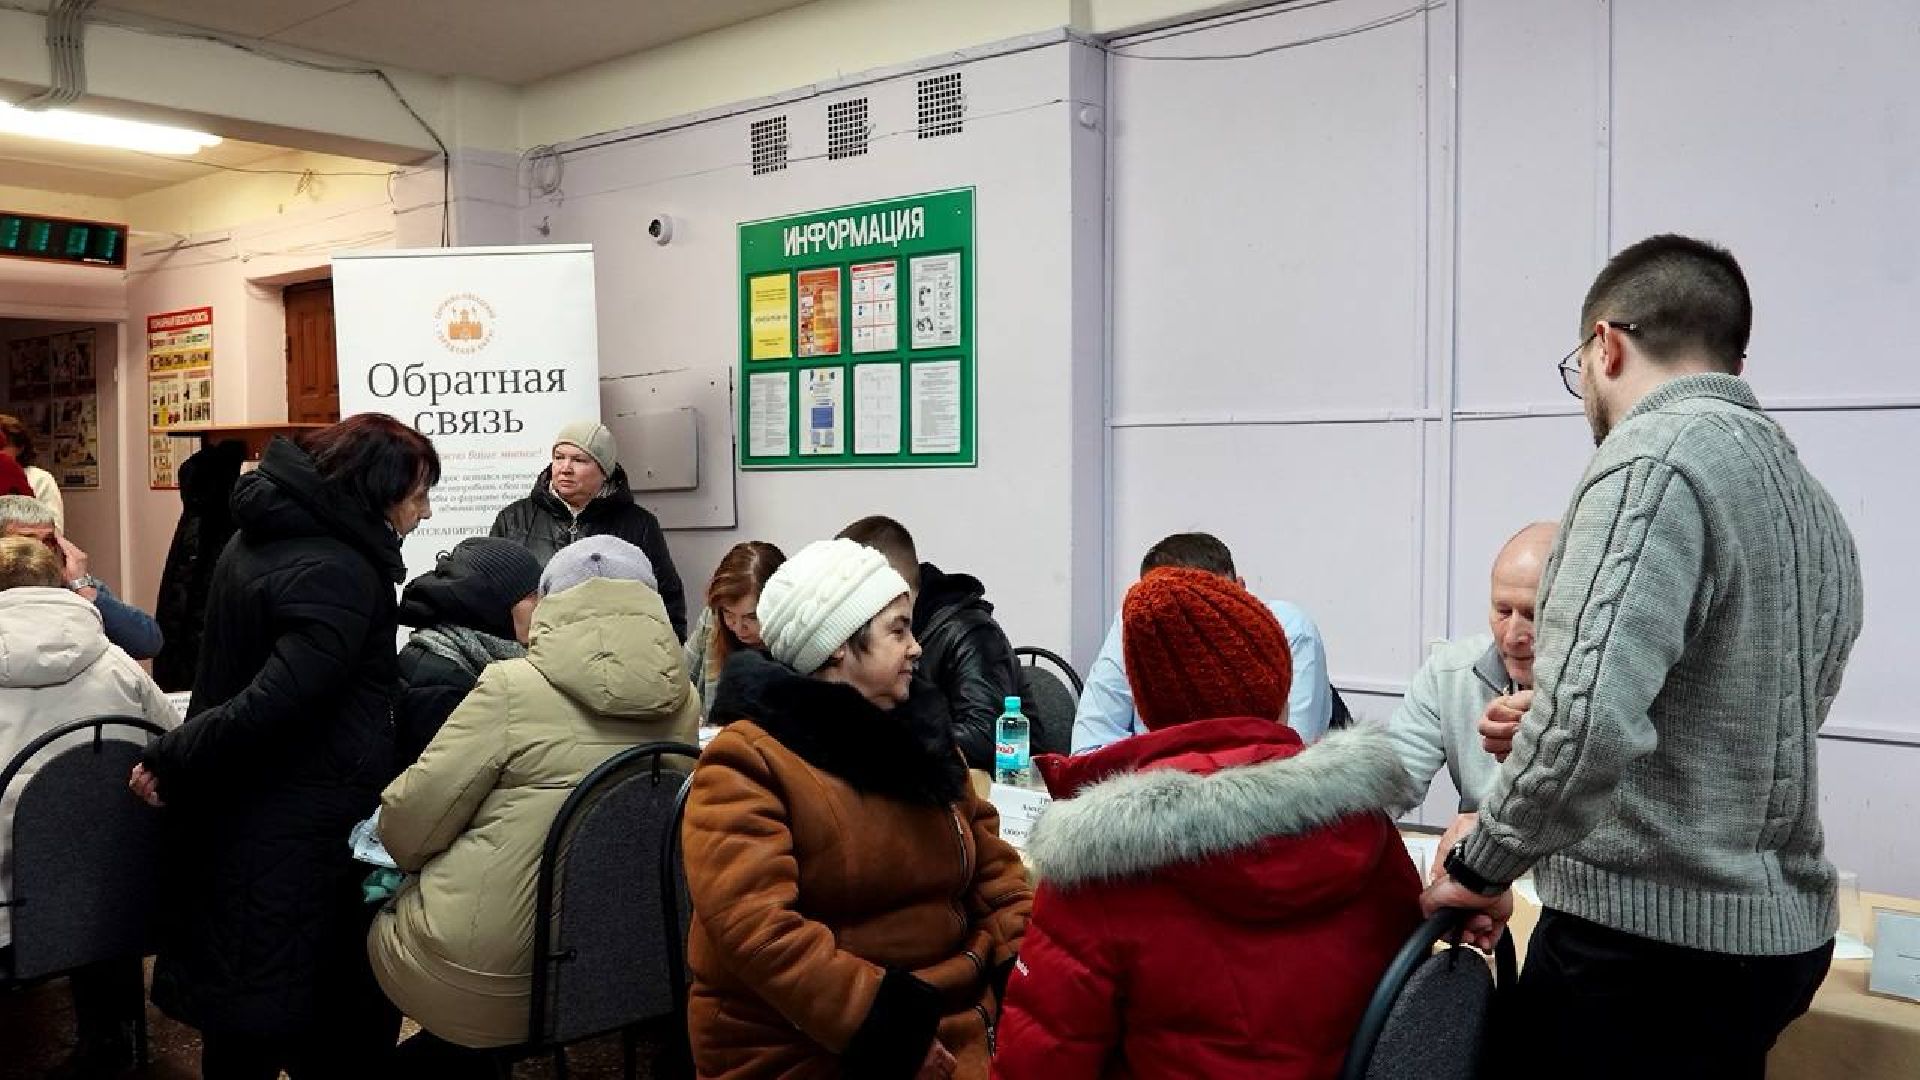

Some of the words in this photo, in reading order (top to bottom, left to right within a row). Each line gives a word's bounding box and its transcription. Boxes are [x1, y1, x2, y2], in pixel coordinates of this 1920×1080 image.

[783, 206, 925, 257] ИНФОРМАЦИЯ
[367, 361, 568, 406] Обратная
[413, 409, 524, 436] связь
